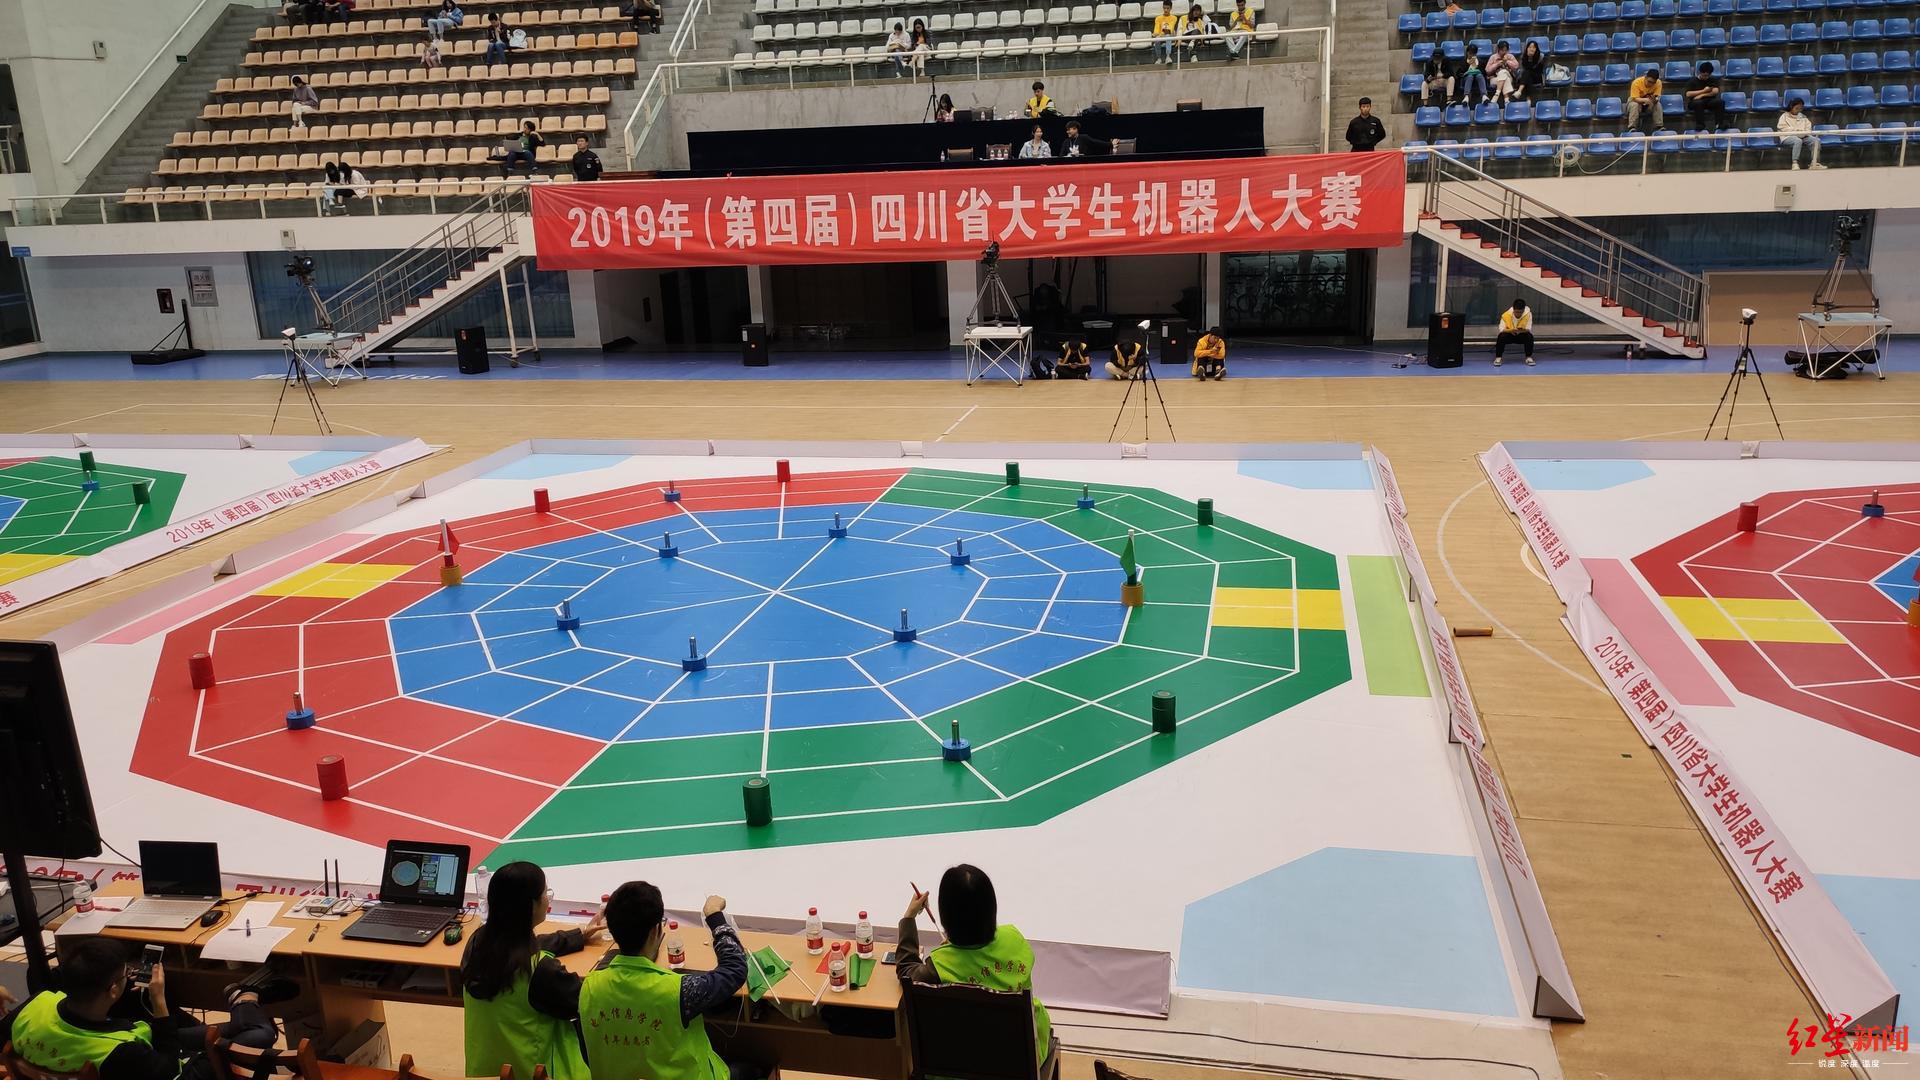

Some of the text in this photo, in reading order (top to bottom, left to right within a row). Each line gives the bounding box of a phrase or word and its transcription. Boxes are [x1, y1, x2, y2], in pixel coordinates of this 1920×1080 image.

[567, 171, 1362, 251] 2019年（第四届）四川省大学生机器人大赛
[1594, 636, 1804, 904] 2019年（第四届）四川省大学生机器人大赛
